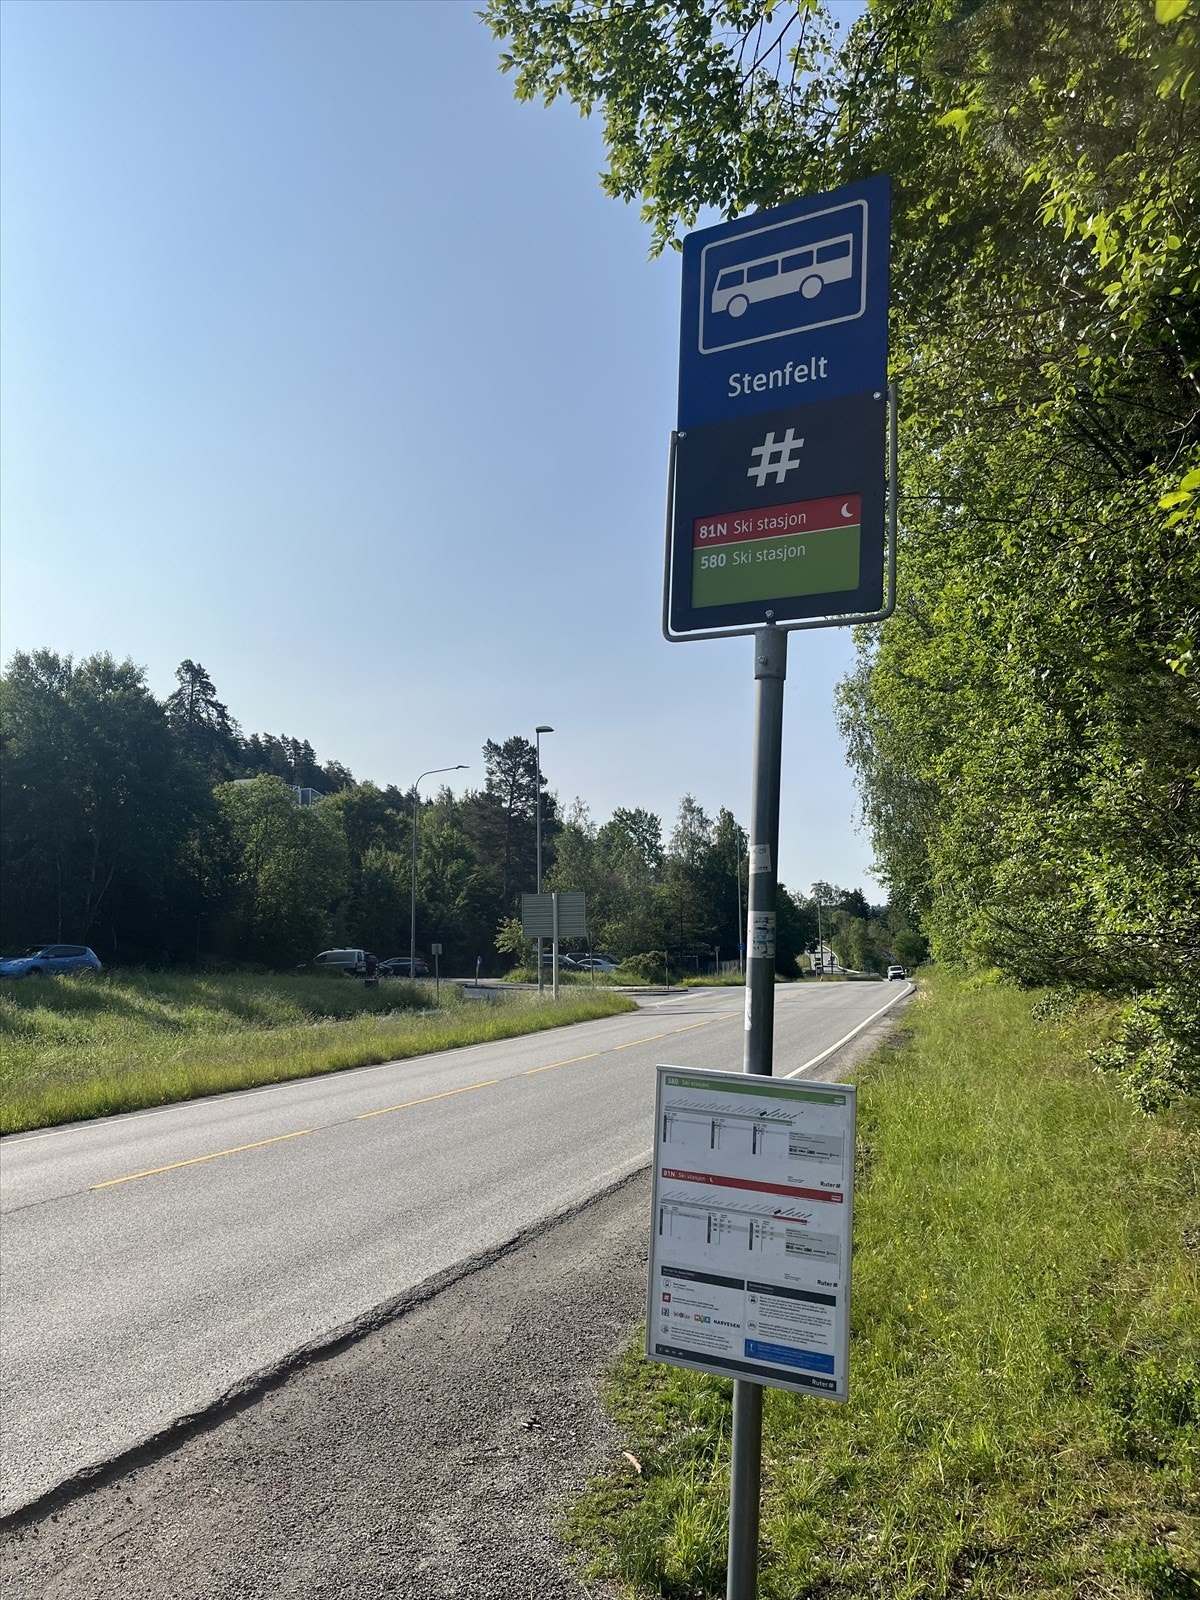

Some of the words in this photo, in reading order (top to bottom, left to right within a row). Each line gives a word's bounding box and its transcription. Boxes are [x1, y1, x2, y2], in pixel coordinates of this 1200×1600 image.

[728, 356, 828, 397] Stenfelt
[699, 522, 727, 539] 81N
[734, 518, 753, 534] Ski
[756, 512, 807, 531] stasjon
[700, 553, 726, 570] 580
[732, 549, 752, 565] Ski
[756, 543, 806, 564] stasjon
[667, 1077, 679, 1085] 580
[663, 1170, 676, 1178] 81N
[713, 1319, 741, 1329] NARVESEN
